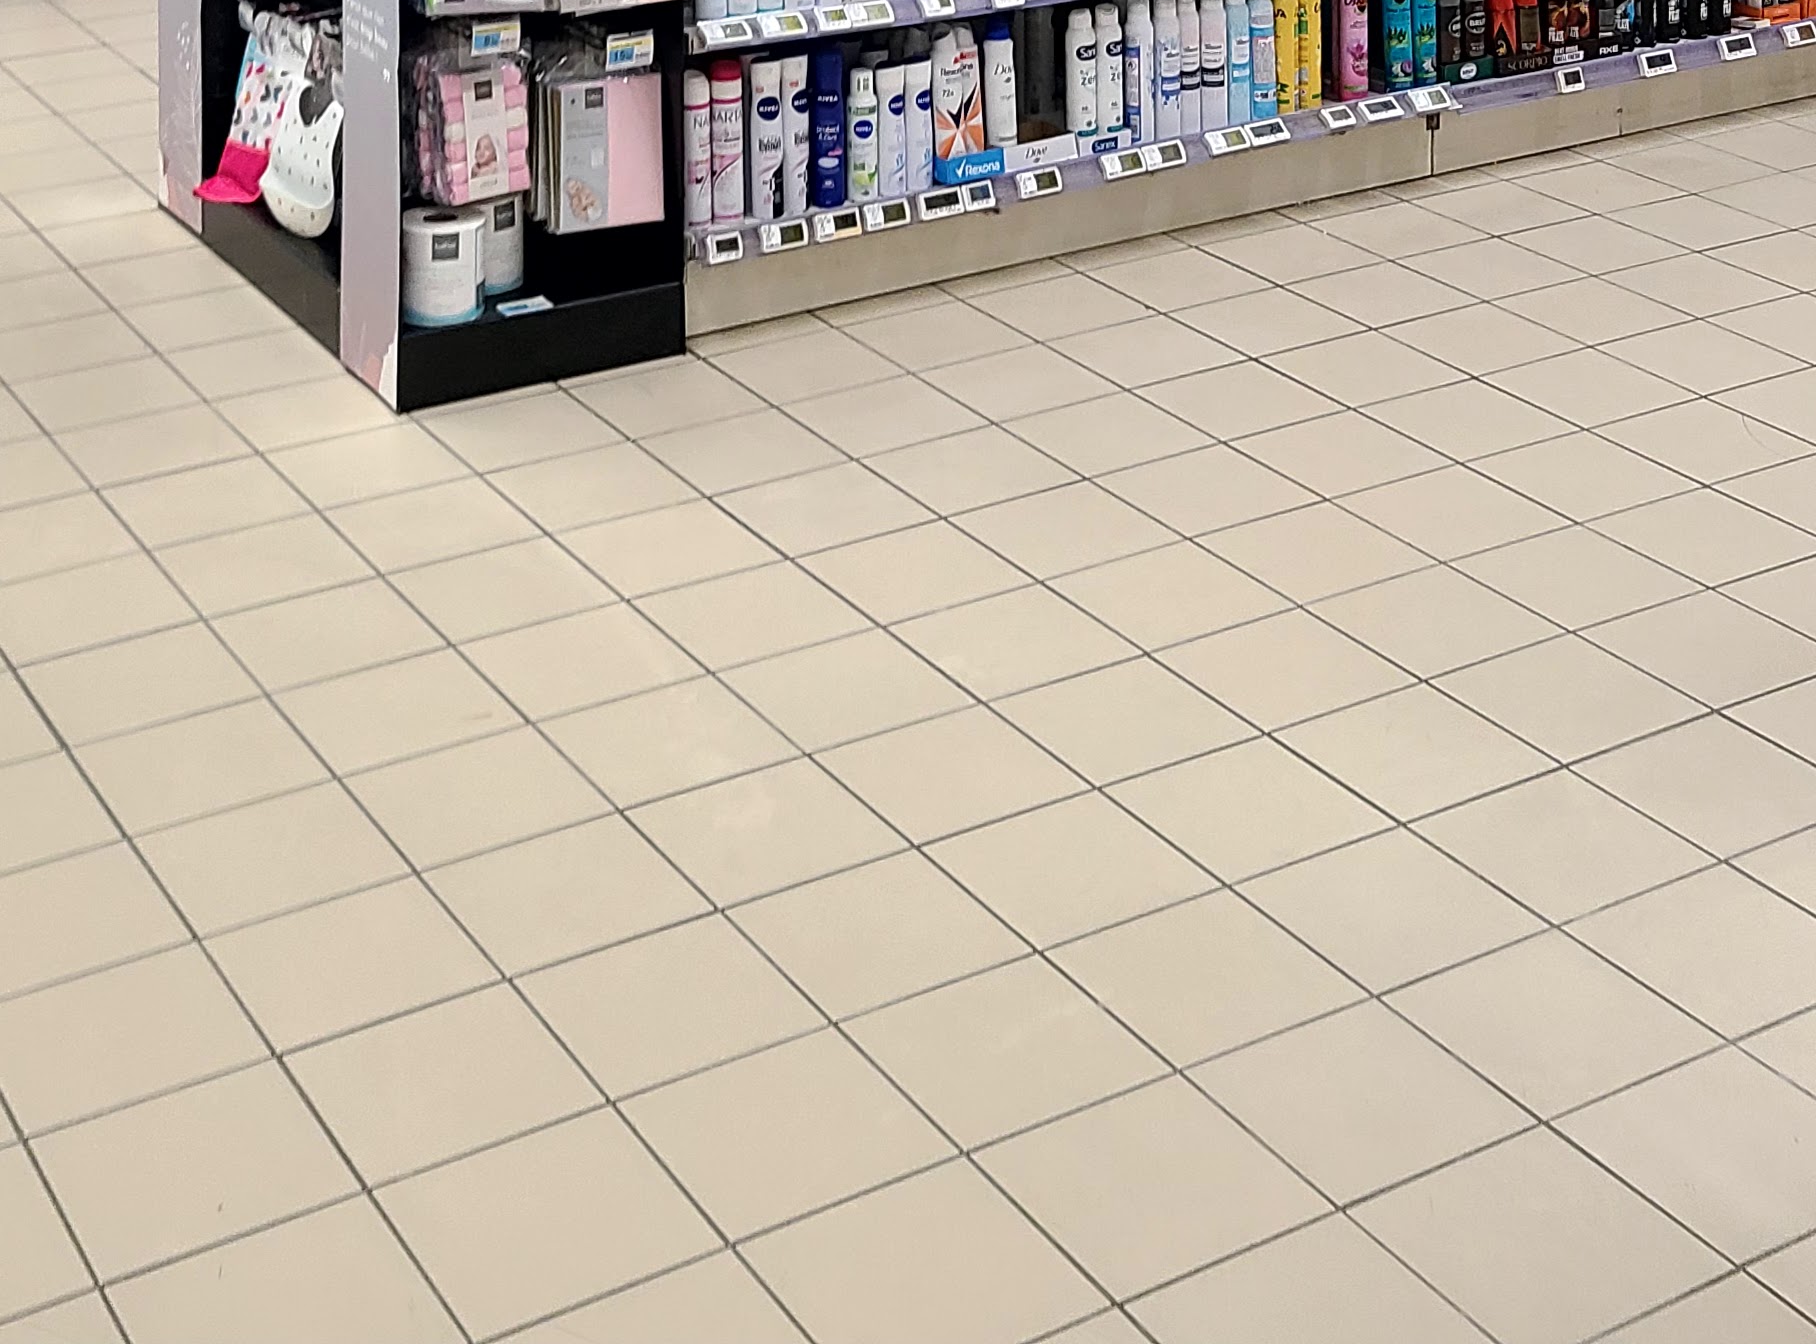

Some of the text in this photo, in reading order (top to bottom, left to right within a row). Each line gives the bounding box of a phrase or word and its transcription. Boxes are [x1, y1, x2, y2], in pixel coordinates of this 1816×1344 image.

[1599, 45, 1619, 55] AXE
[994, 64, 1013, 76] Dov
[1093, 139, 1117, 151] Sanex
[1025, 146, 1048, 158] Dove
[965, 161, 1001, 176] Rexona
